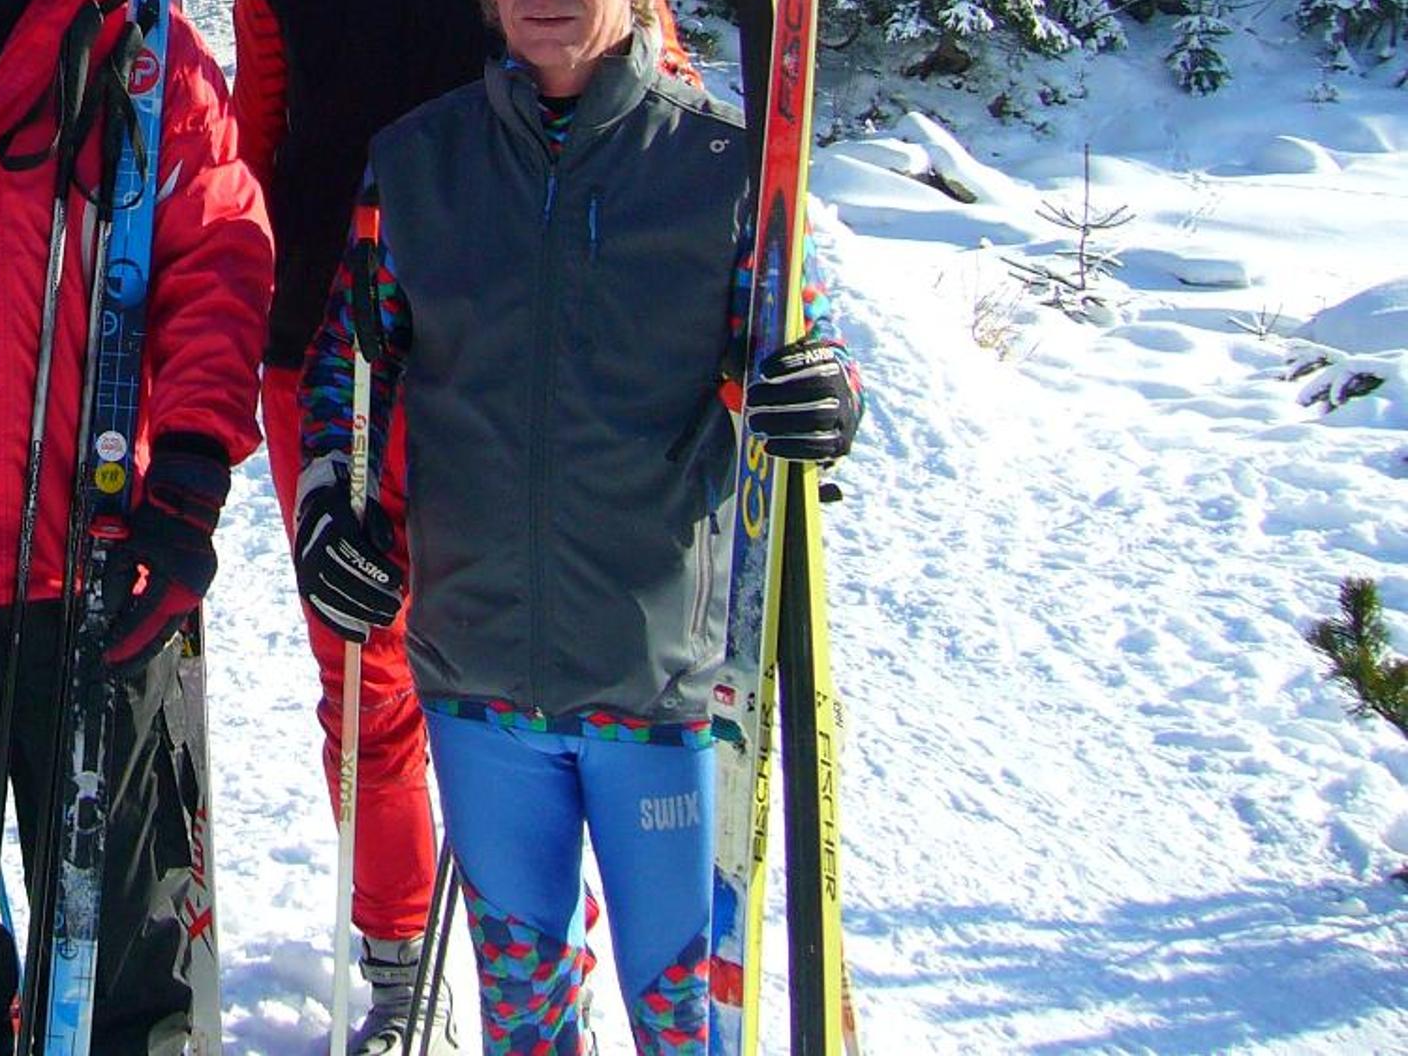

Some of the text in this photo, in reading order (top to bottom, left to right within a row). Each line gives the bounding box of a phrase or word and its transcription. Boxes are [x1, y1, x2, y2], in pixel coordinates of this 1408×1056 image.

[640, 791, 699, 831] SWIX
[753, 702, 773, 863] FISCHER
[817, 729, 836, 902] FISCHER
